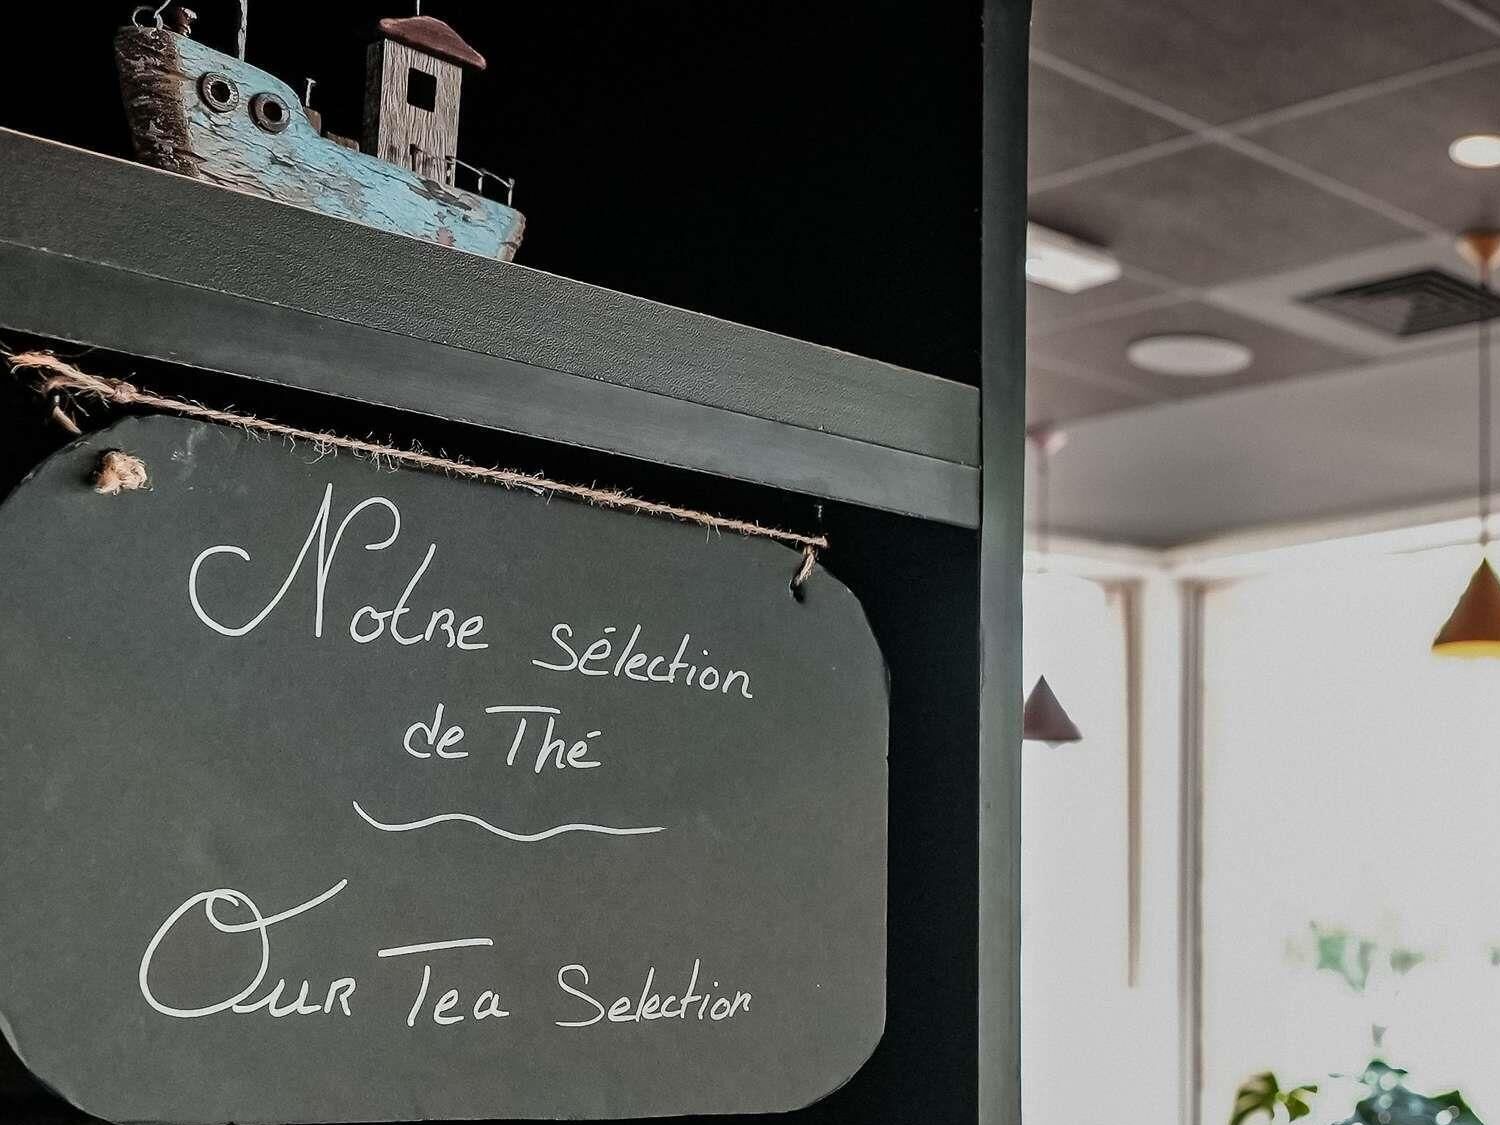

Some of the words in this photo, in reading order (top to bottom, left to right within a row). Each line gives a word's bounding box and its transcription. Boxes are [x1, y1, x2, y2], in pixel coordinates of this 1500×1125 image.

[531, 623, 753, 698] Sélection
[404, 703, 468, 758] de
[485, 705, 602, 773] Thé
[378, 938, 509, 1026] Tea
[556, 959, 752, 1027] Selection
